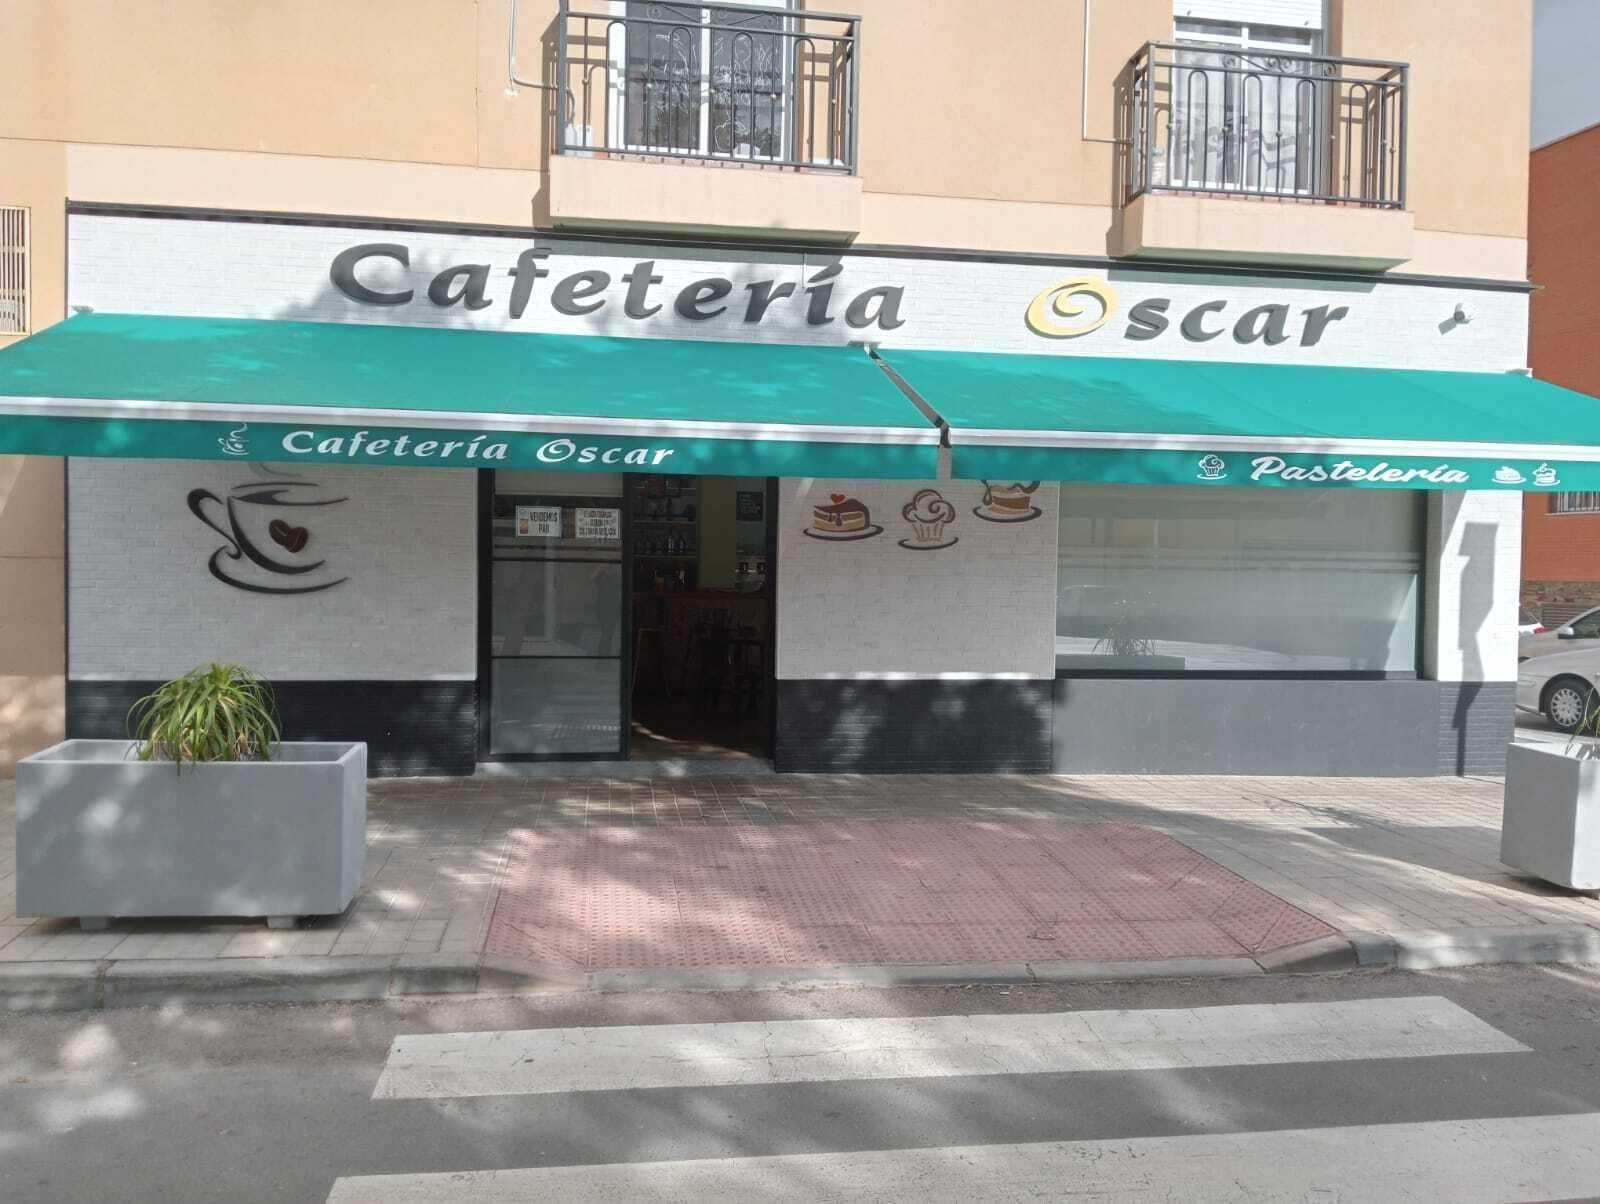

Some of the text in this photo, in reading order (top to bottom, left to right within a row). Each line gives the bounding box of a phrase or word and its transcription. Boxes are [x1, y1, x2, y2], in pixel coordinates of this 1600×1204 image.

[330, 242, 1350, 348] Cafetería Oscar
[282, 430, 675, 467] Cafetería Oscar
[1251, 456, 1470, 484] Pastelería
